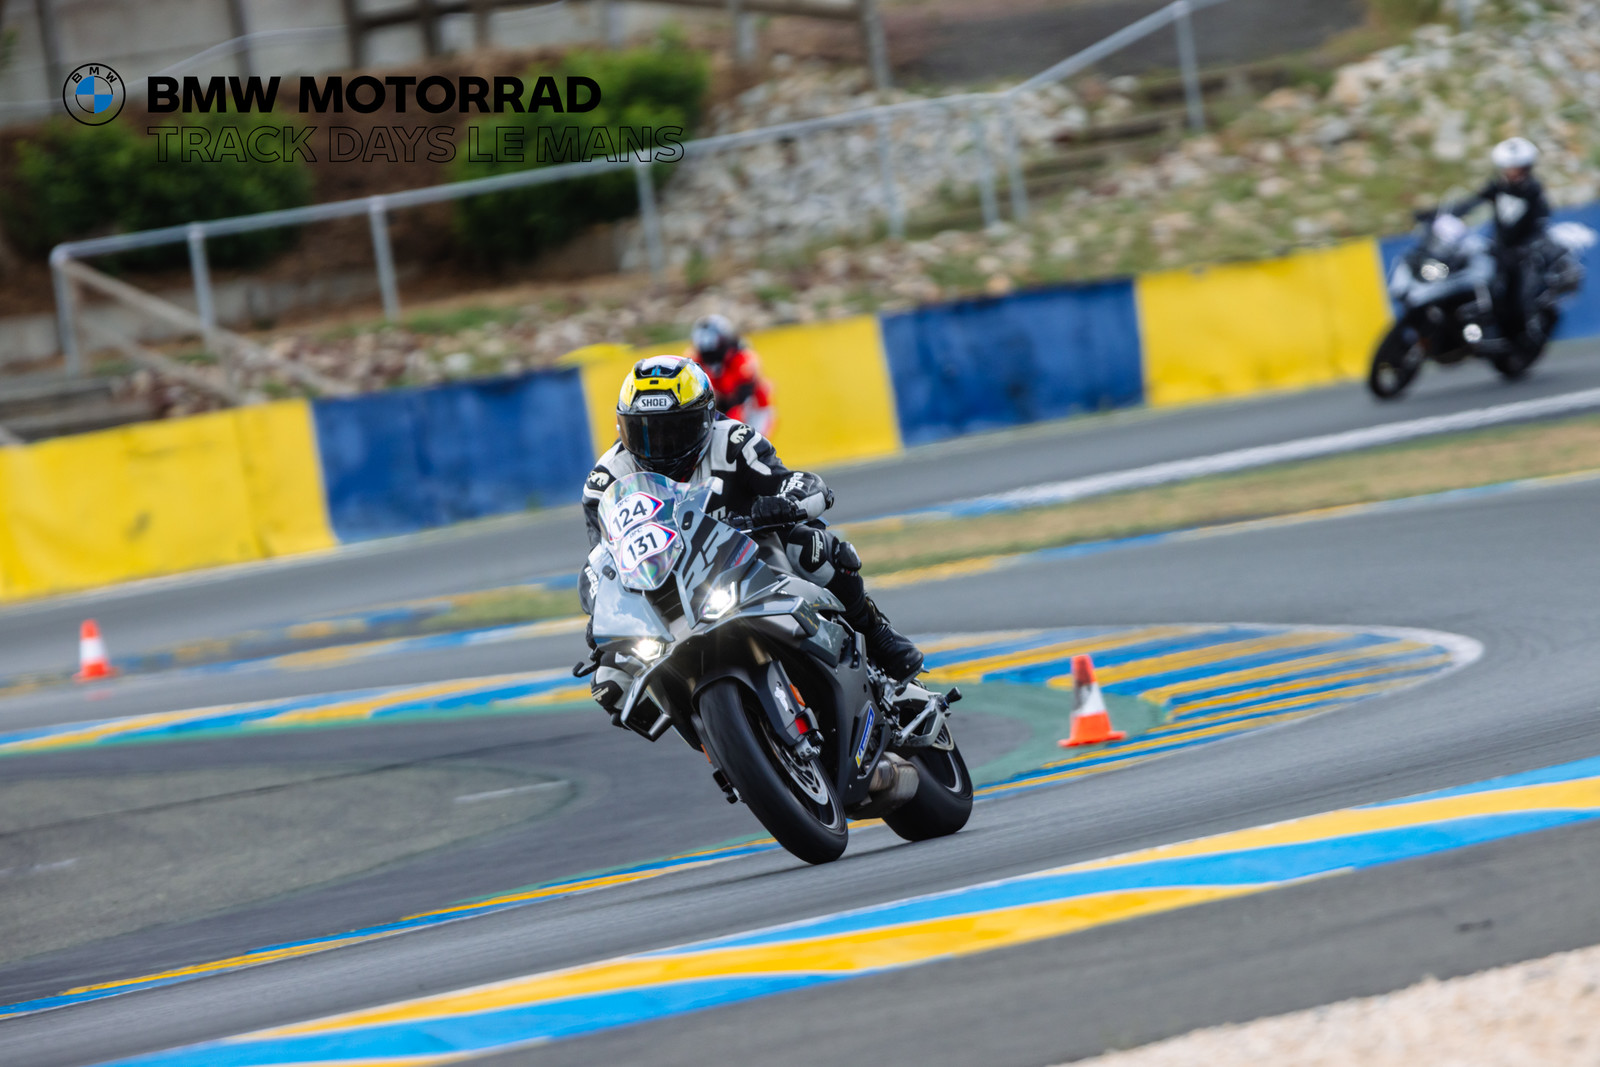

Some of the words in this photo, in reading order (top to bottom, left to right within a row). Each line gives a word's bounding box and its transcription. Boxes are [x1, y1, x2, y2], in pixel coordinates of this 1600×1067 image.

[641, 398, 667, 408] SHOEI
[612, 500, 648, 532] 124
[627, 532, 658, 561] 131
